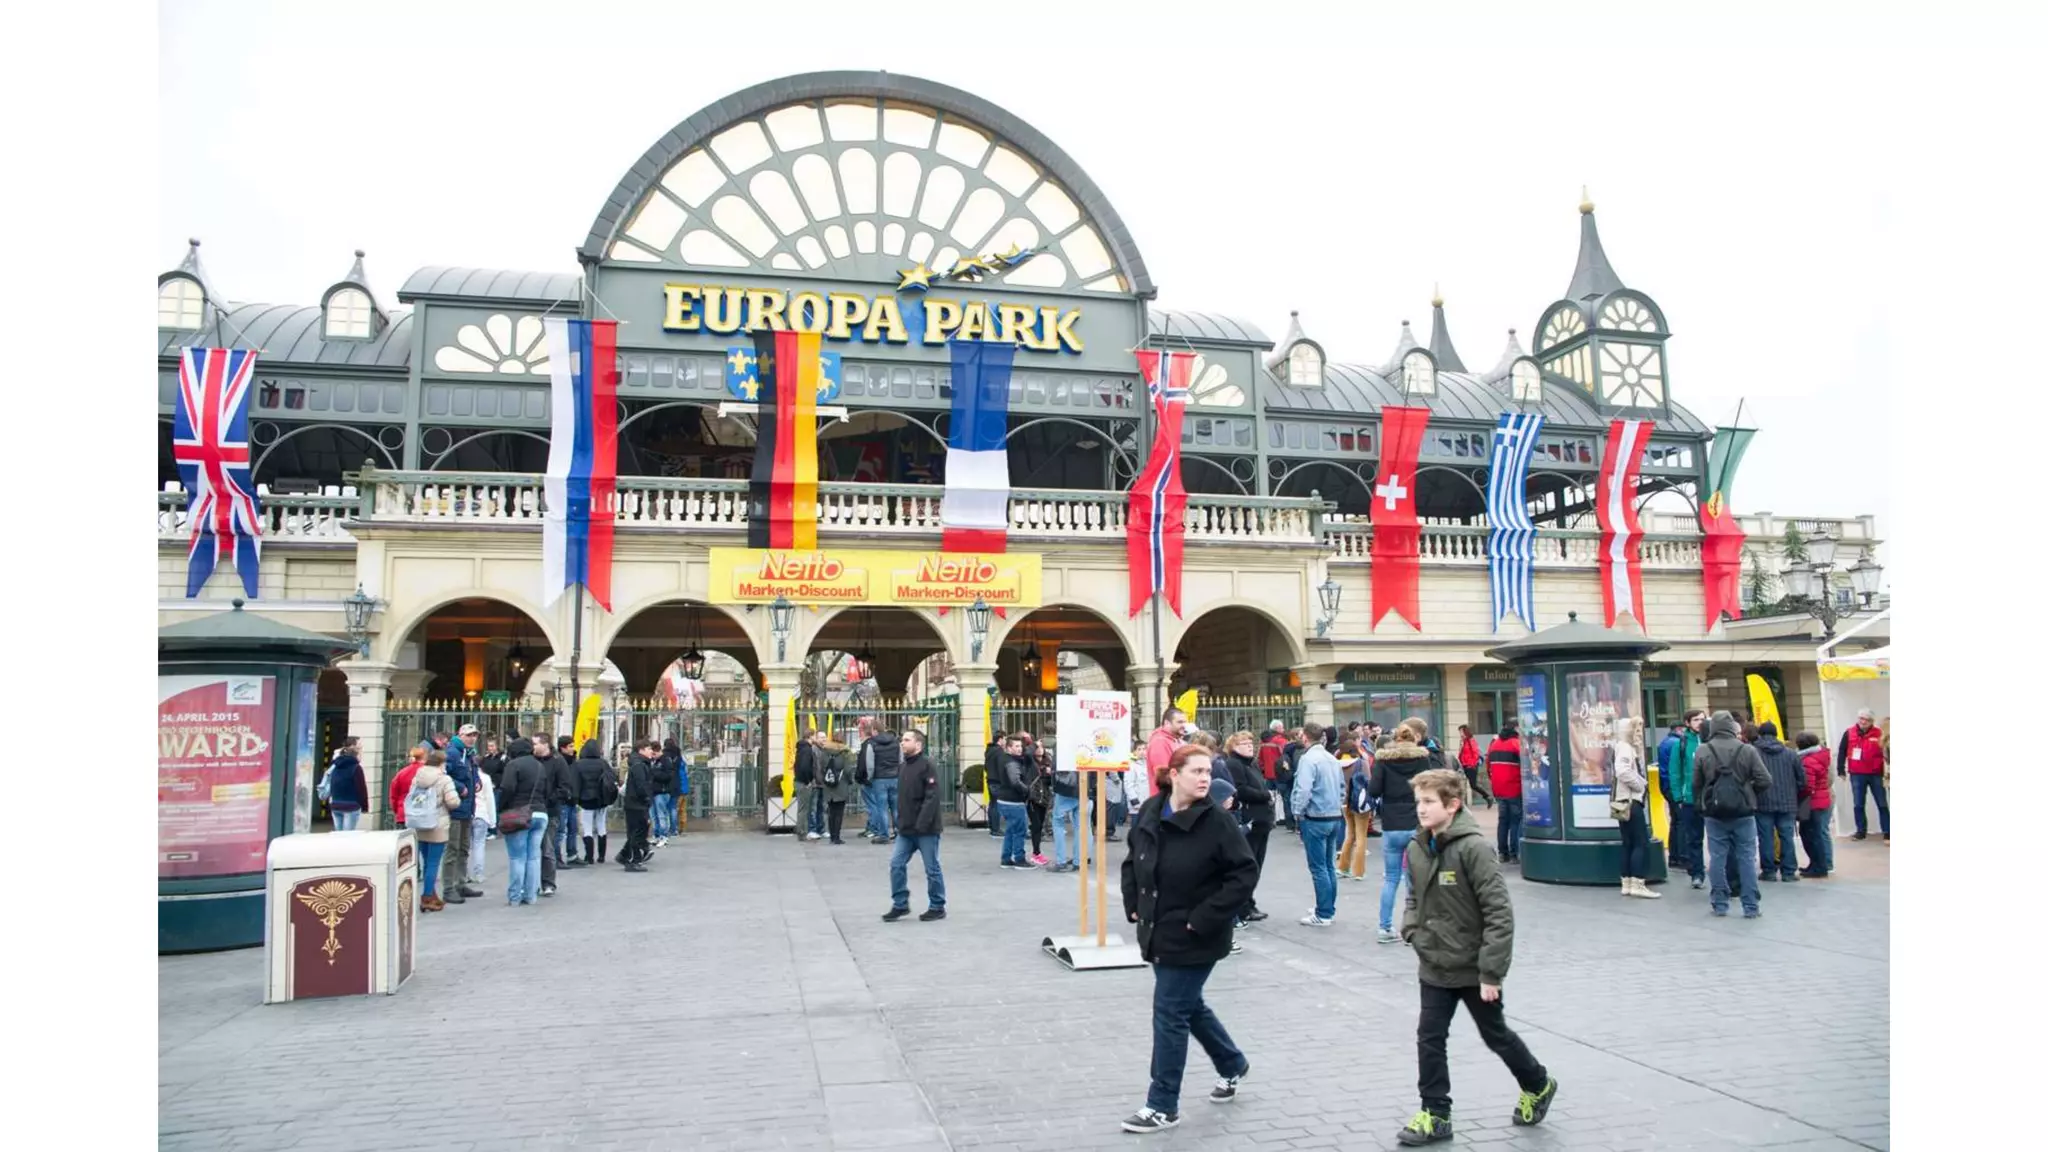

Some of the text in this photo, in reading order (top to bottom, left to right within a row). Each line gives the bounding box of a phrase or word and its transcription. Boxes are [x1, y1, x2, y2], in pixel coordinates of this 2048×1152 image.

[663, 283, 1084, 354] EUROPA PARK
[759, 550, 844, 580] Netto
[917, 552, 998, 583] Netto
[739, 583, 862, 598] Marken-Discount
[897, 585, 1015, 599] Marken-Discount
[1354, 670, 1416, 681] Information
[176, 713, 209, 721] APRIL
[211, 712, 240, 721] 2015
